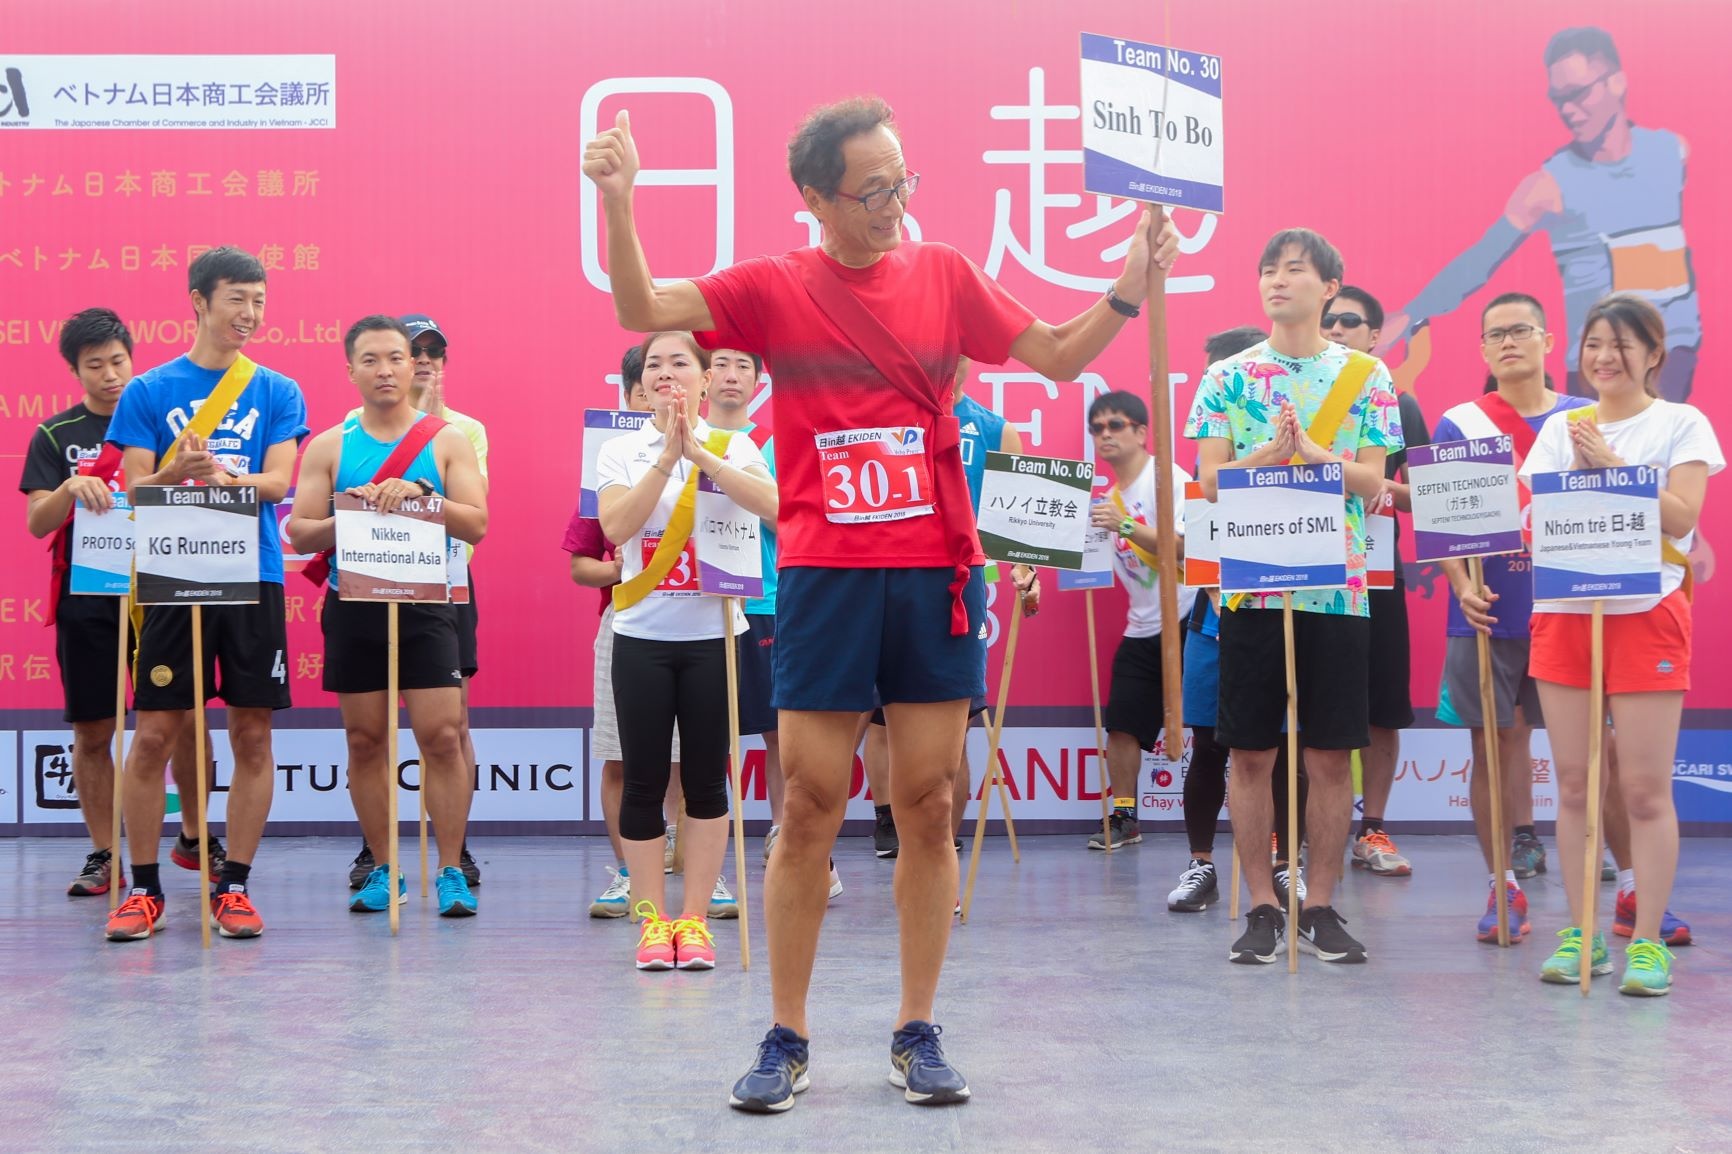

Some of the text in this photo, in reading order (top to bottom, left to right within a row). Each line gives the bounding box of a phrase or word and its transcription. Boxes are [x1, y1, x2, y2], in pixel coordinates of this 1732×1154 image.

[1113, 39, 1219, 80] Team No. 30
[53, 82, 330, 106] ベトナム日本商工会議所
[54, 119, 69, 127] The
[71, 119, 111, 129] Japanese
[112, 119, 150, 127] Chamber
[152, 119, 161, 127] of
[162, 119, 207, 127] Commerce
[209, 119, 225, 127] and
[227, 119, 257, 129] Industry
[260, 119, 267, 127] in
[269, 118, 302, 127] Vietnam
[1093, 100, 1212, 147] Sinh To Bo
[820, 432, 882, 447] 日in越 EKIDEN
[821, 450, 849, 460] Team
[1430, 436, 1512, 462] Team No. 36
[1010, 456, 1092, 479] Team No. 06
[1246, 464, 1341, 486] Team No. 08
[827, 459, 924, 509] 30-1
[1417, 475, 1509, 496] SEPTENI TECHNOLOGY
[1559, 466, 1655, 490] Team No. 01
[163, 488, 255, 504] Team No. 11
[401, 500, 423, 512] No.
[427, 498, 443, 512] 47
[990, 496, 1077, 519] ハノイ立教会
[1009, 516, 1055, 529] Rikkyo University
[1227, 517, 1337, 538] Runners of SML
[1545, 518, 1584, 536] Nhóm
[82, 536, 122, 550] PROTO
[371, 527, 410, 542] Nikken
[1634, 539, 1652, 547] Team
[149, 537, 246, 555] KG Runners
[341, 550, 441, 565] International Asia
[271, 650, 286, 684] 4
[1142, 796, 1175, 811] Chạy
